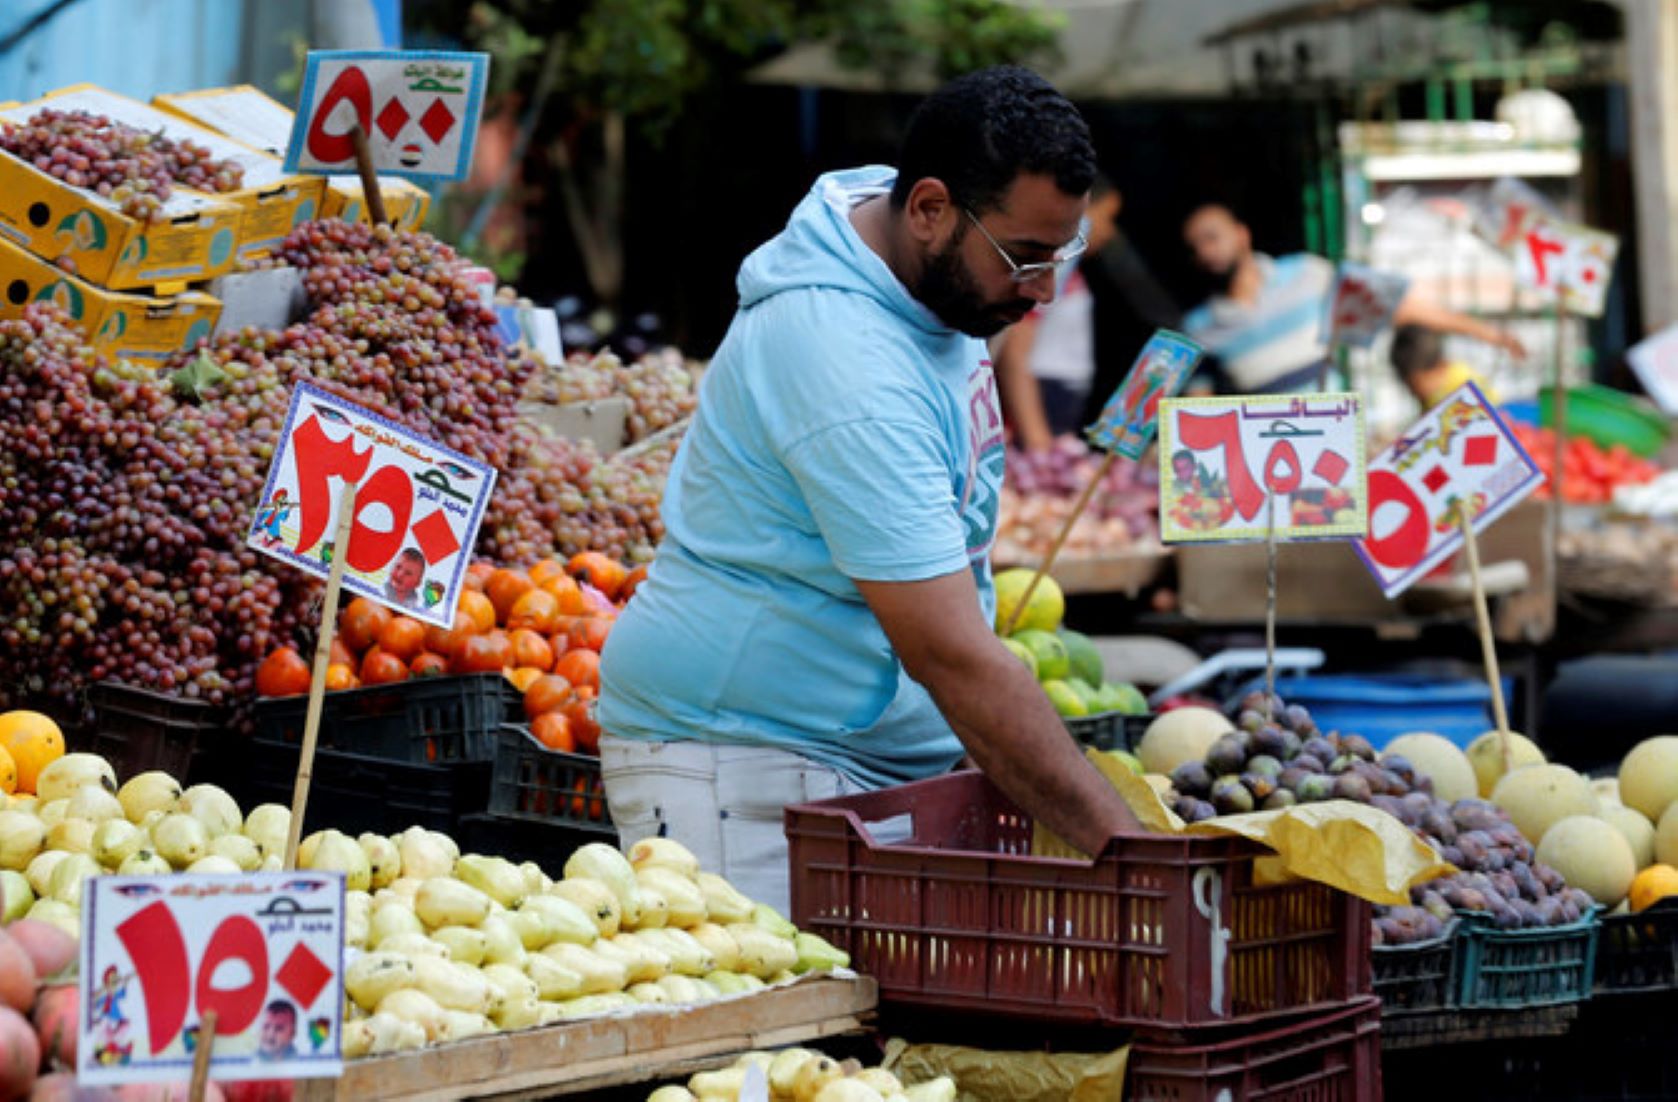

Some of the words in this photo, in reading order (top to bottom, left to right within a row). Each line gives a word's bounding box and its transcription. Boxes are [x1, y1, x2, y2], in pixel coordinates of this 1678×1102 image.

[307, 66, 456, 163] ٥٠٠
[292, 413, 461, 573] ٣٥٠
[1177, 409, 1350, 522] ٦٥٠
[1362, 434, 1498, 569] ٥٠٠
[115, 899, 335, 1057] ١٥٠
